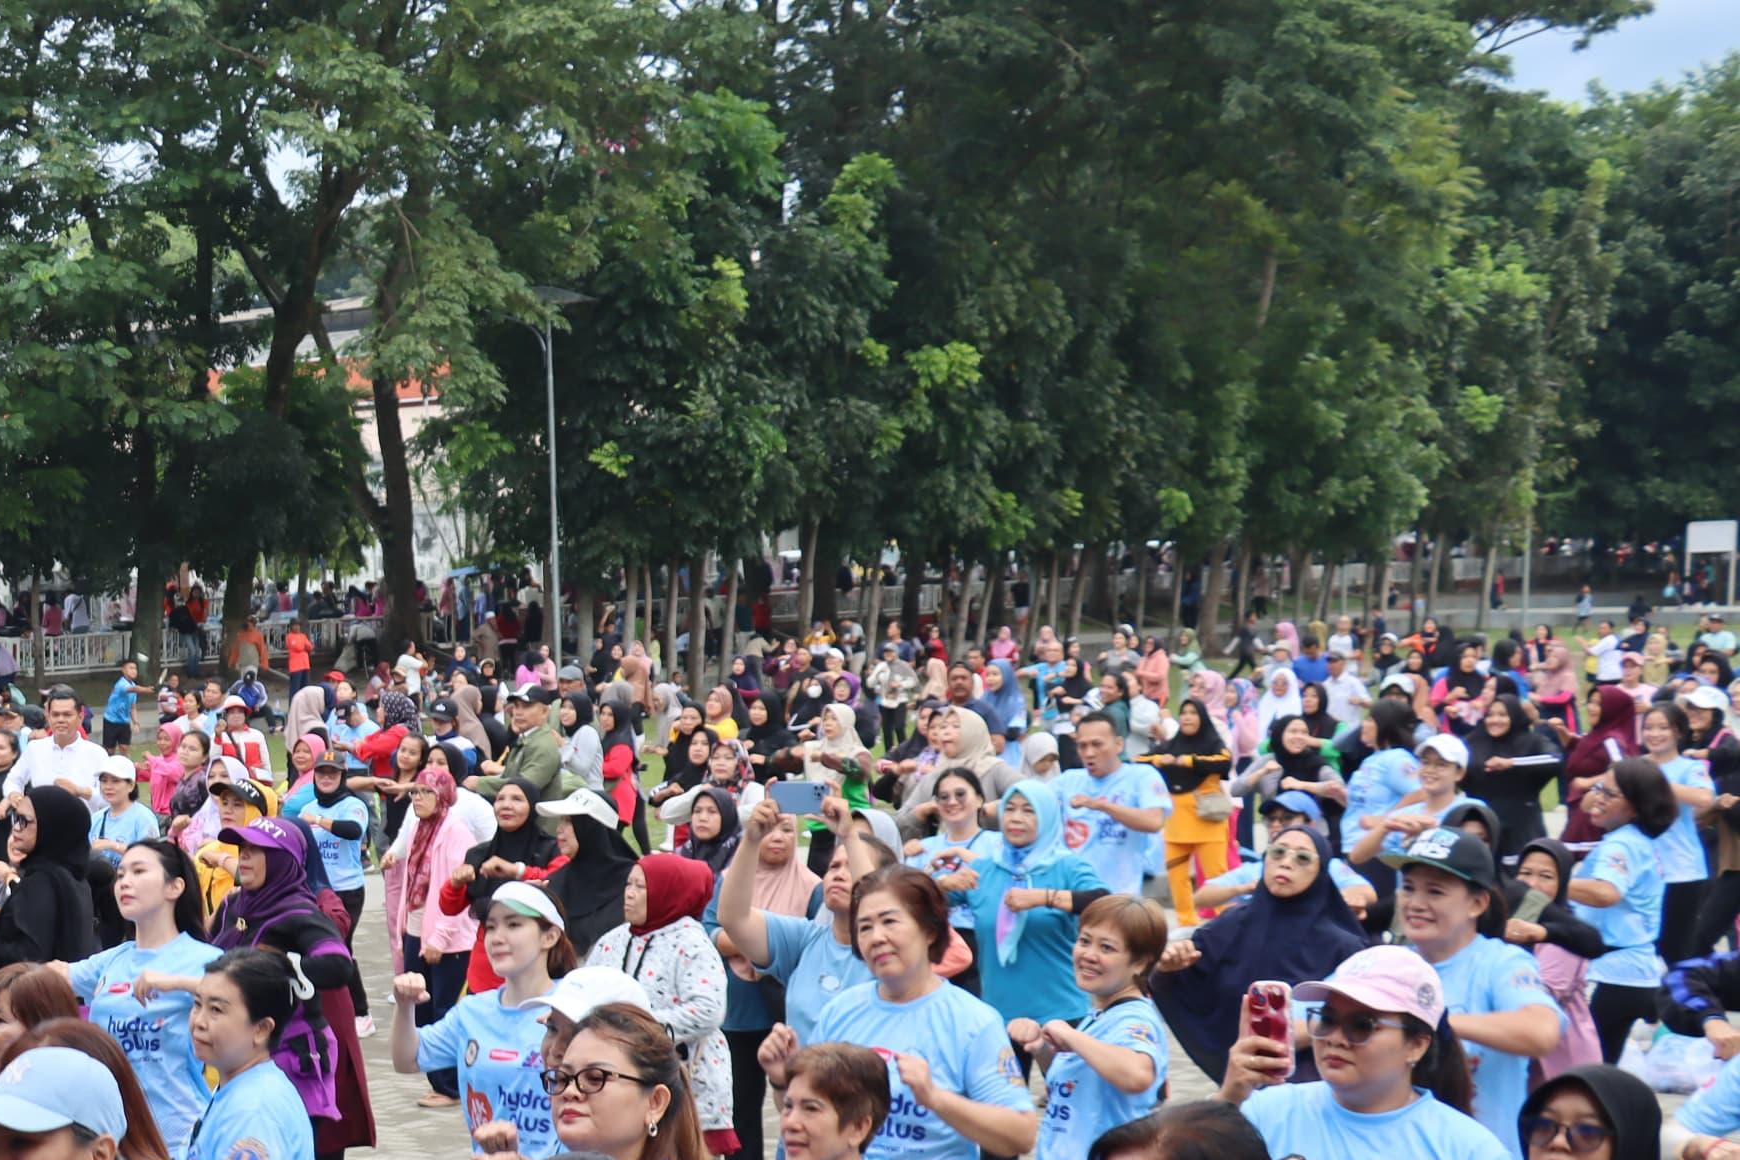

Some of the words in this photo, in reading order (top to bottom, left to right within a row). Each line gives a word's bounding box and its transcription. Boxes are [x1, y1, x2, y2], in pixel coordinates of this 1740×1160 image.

[108, 1016, 161, 1038] hydro
[498, 1085, 551, 1111] hydro
[890, 1093, 928, 1118] dro
